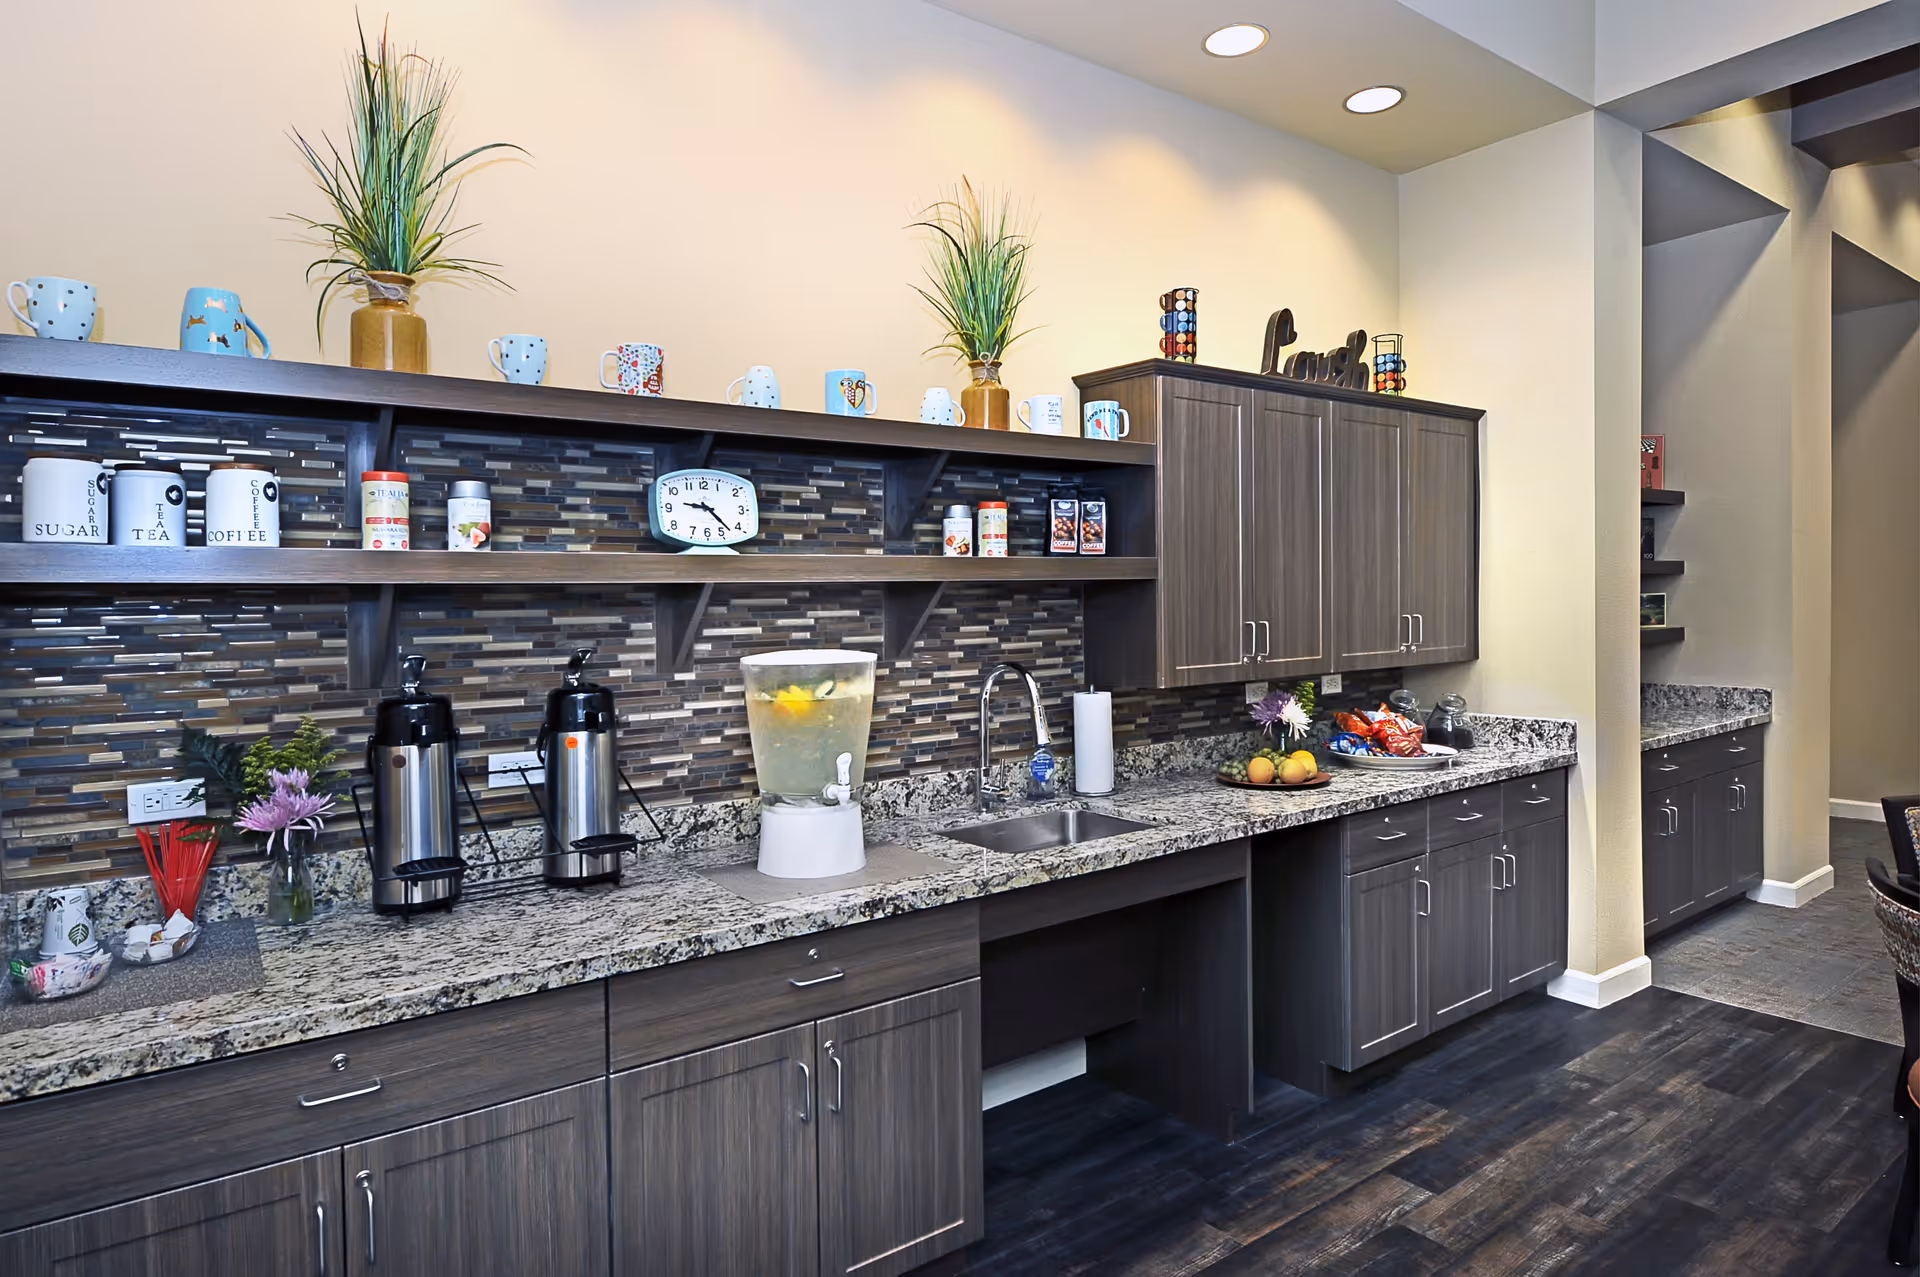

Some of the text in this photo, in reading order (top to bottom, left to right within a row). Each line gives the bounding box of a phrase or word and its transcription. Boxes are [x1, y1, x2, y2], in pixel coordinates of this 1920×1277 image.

[685, 482, 692, 490] 11
[699, 481, 708, 490] 12
[669, 487, 678, 495] 10
[732, 488, 739, 497] 2
[87, 479, 96, 524] SUGAR
[250, 479, 260, 529] COFFEE
[665, 503, 672, 512] 9
[738, 505, 744, 515] 3
[155, 503, 164, 528] TEA
[671, 520, 677, 530] 8
[735, 522, 741, 530] 4
[35, 523, 100, 537] SUGAR
[131, 528, 171, 541] TEA
[689, 526, 696, 535] 7
[704, 528, 711, 537] 6
[718, 527, 724, 536] 5
[207, 530, 267, 542] COFFEE
